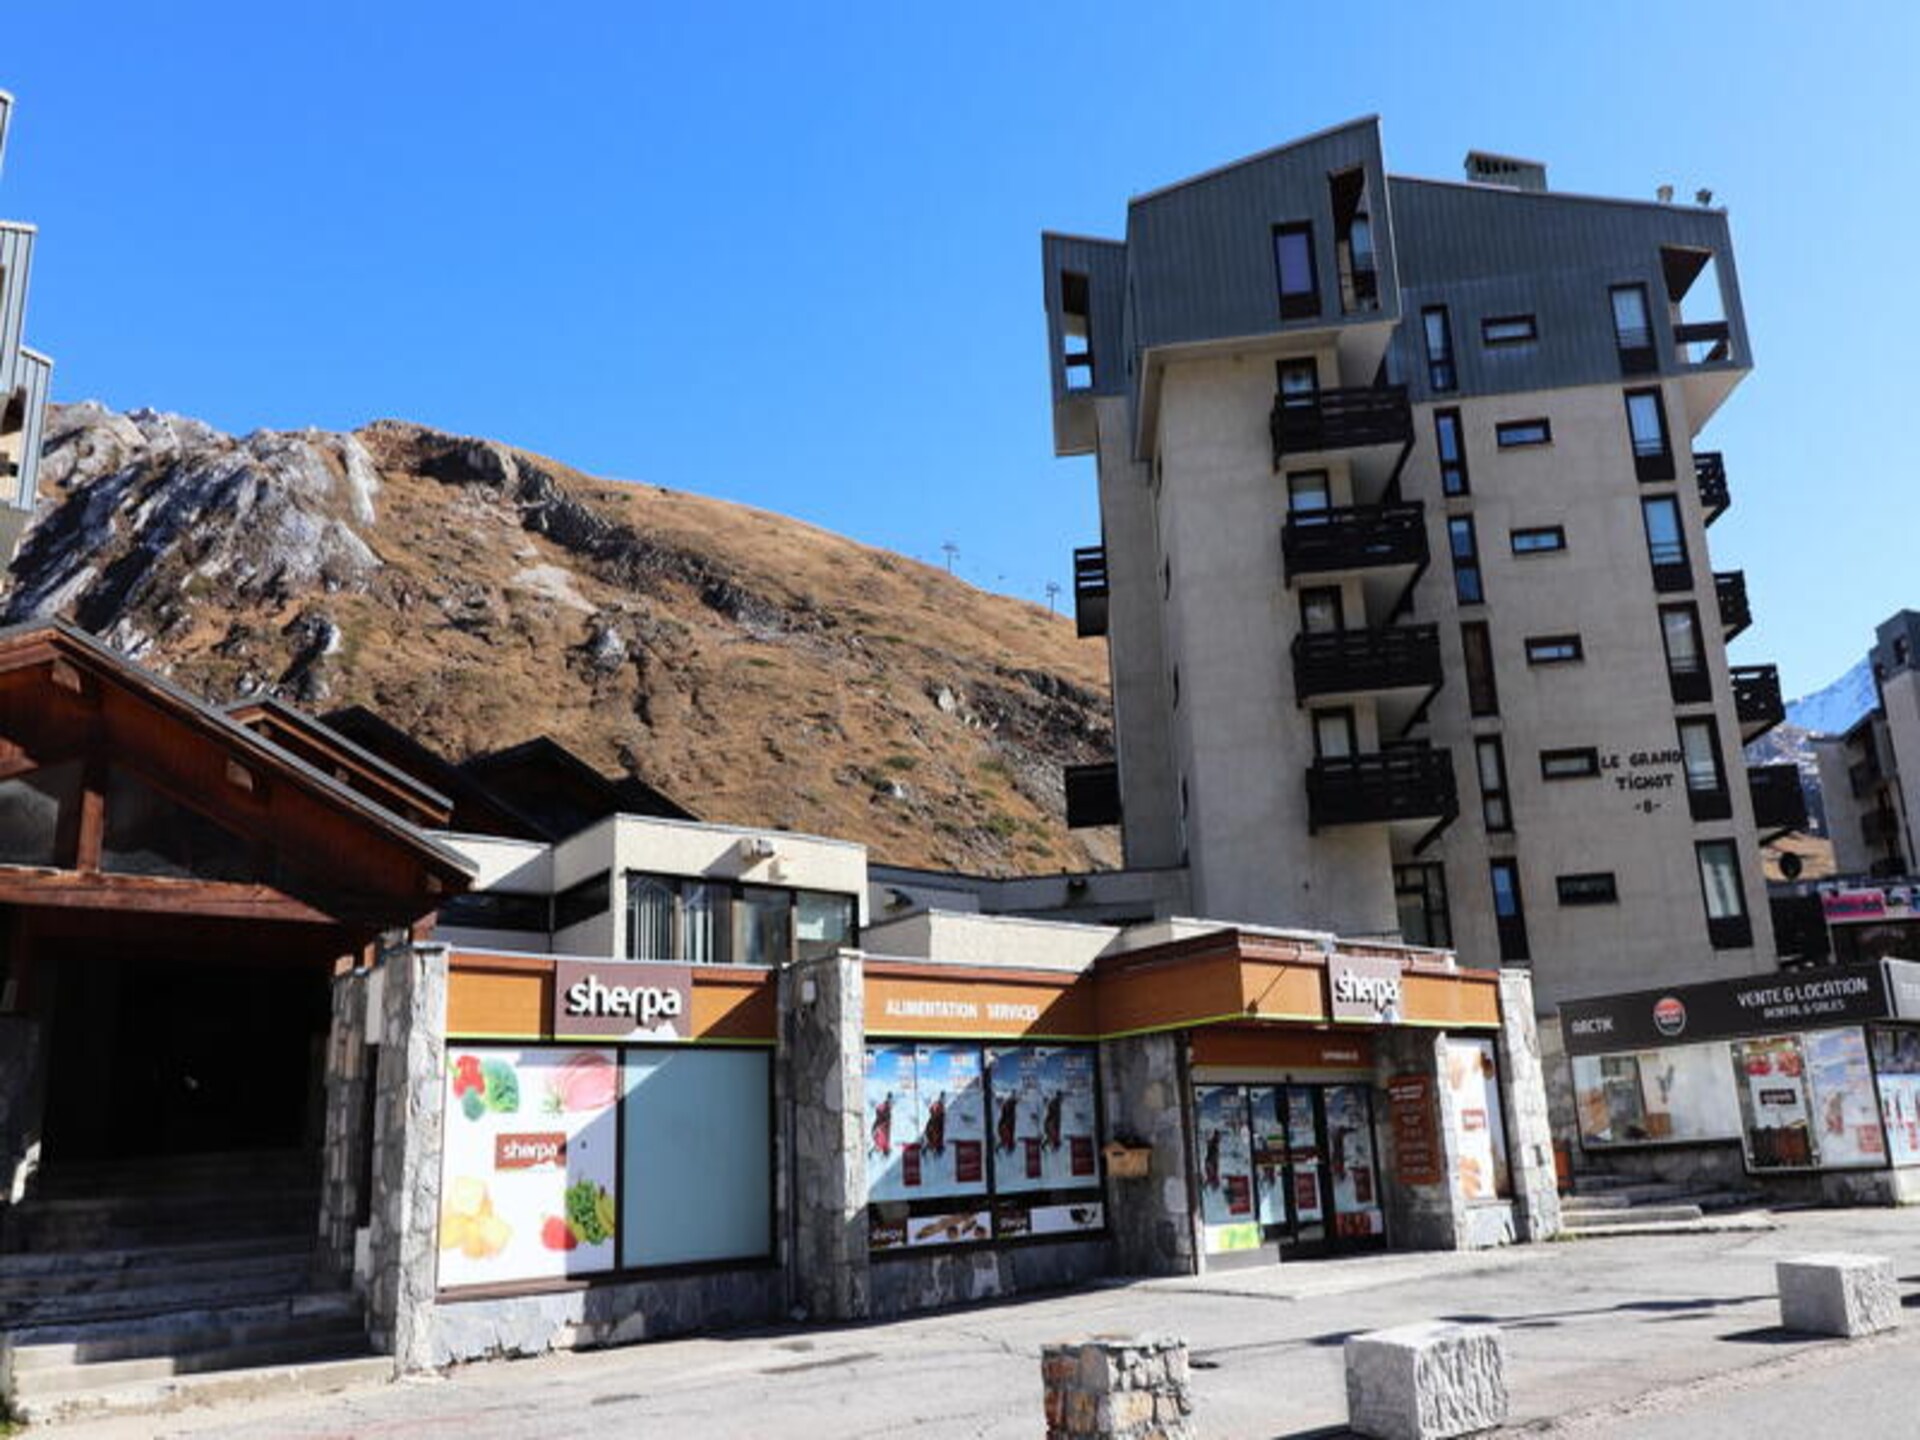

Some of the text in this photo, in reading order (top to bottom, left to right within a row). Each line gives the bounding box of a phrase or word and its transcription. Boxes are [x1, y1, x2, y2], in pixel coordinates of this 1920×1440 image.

[1601, 750, 1684, 769] LE GRAND
[566, 975, 682, 1025] sherpa
[1335, 967, 1400, 1013] sherpa
[1737, 987, 1782, 1008] VENTE
[1795, 977, 1868, 1001] LOCATION
[885, 1000, 1039, 1021] ALIMENTATION SERVICES
[503, 1140, 558, 1161] sherpa
